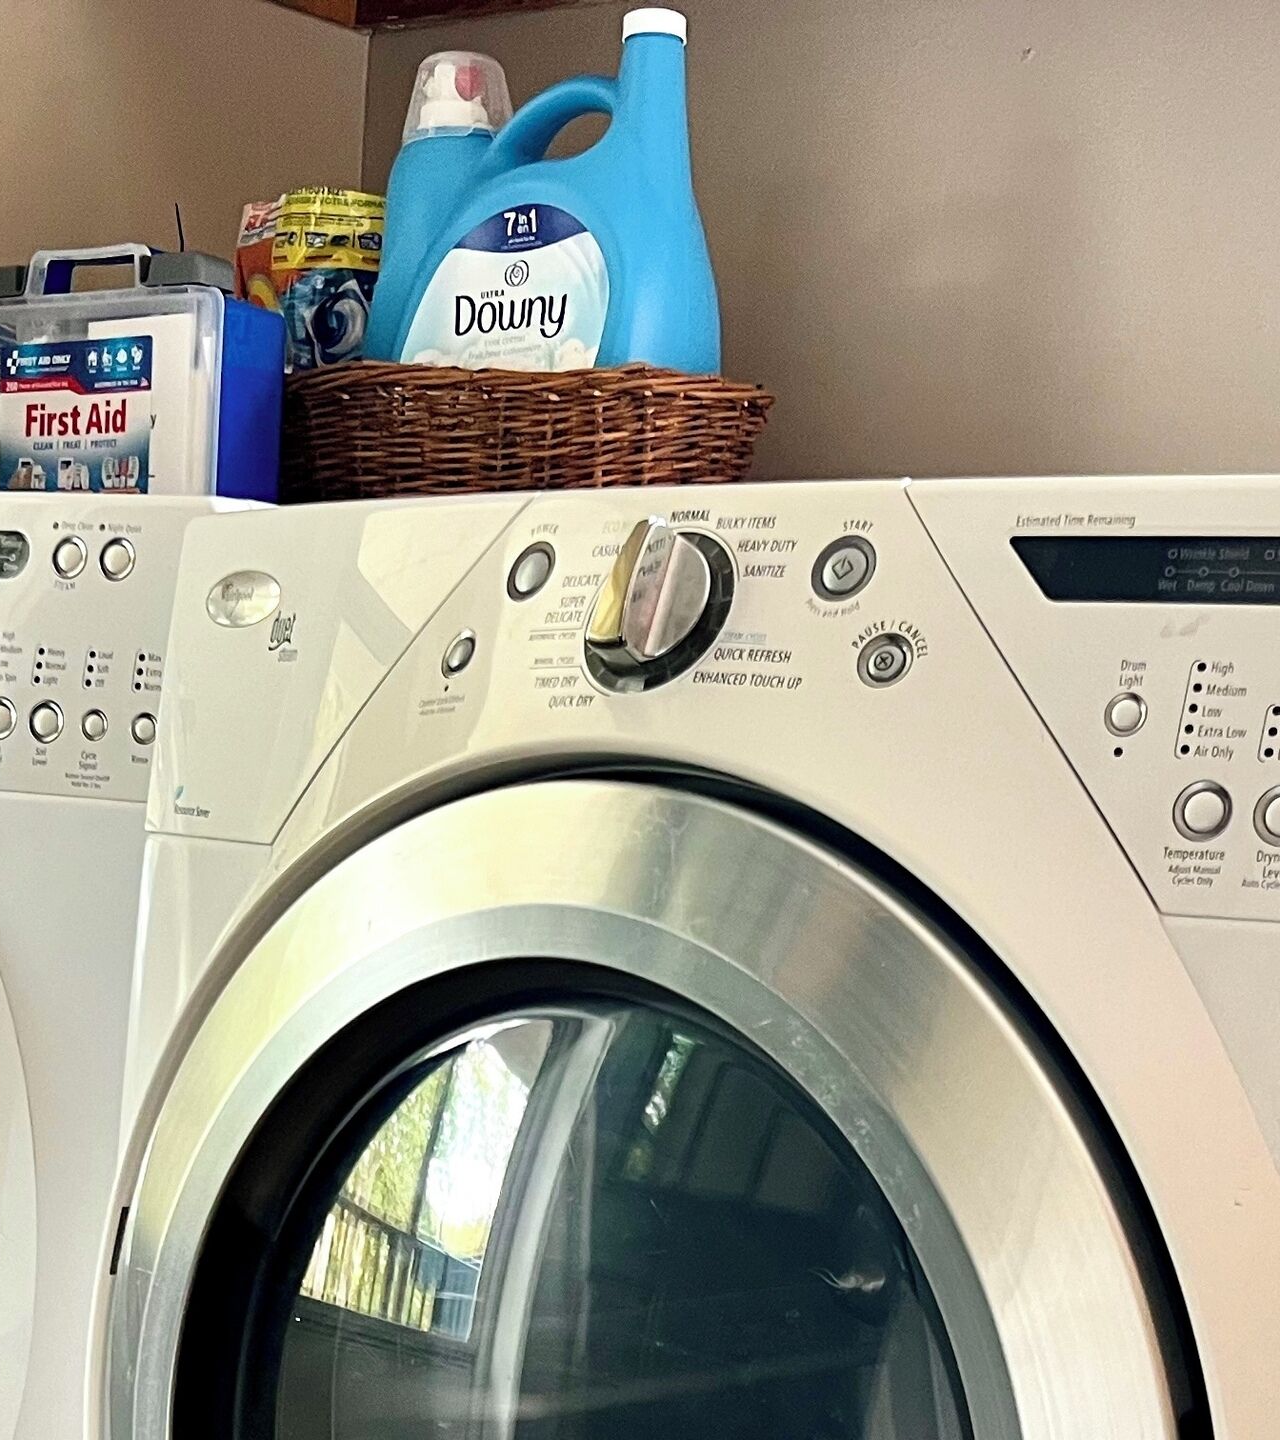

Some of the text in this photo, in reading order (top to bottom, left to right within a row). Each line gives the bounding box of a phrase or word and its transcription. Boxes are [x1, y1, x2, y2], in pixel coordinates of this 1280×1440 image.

[503, 208, 537, 236] 7 in 1
[480, 289, 505, 299] ULTRA
[455, 293, 568, 338] Downy
[38, 355, 51, 366] AID
[25, 403, 81, 438] First
[85, 398, 127, 435] Aid
[33, 439, 117, 451] CLEAN TREAT PROTECT
[670, 509, 711, 522] NORMAL
[1016, 514, 1136, 529] Estimated Time Remaining
[716, 517, 777, 529] BULKY ITEMS
[843, 520, 873, 533] START
[737, 540, 799, 552] HEAVY DUTY
[1179, 547, 1250, 561] Wrinkle Shield
[743, 565, 787, 578] SANITIZE
[562, 574, 602, 588] DELICATE
[1158, 580, 1178, 592] Wet
[1187, 579, 1216, 593] Damp
[1221, 579, 1274, 593] Cool Down
[560, 596, 586, 608] SUPER
[544, 611, 583, 624] DELICATE
[851, 620, 886, 649] PAUSE
[898, 620, 928, 659] CANCEL
[714, 648, 792, 663] QUICK REFRESH
[1121, 660, 1147, 671] Drum
[1211, 662, 1234, 678] High
[534, 676, 580, 689] TIMED DRY
[692, 671, 803, 691] ENHANCED TOUCH UP
[1119, 674, 1143, 689] Light
[1206, 684, 1247, 696] Medium
[548, 695, 595, 709] QUICK DRY
[1202, 705, 1223, 717] Low
[1197, 726, 1247, 738] Extra Low
[1193, 746, 1234, 761] Air Only
[1163, 846, 1226, 862] Temperature
[1168, 864, 1221, 876] Adjust Manual
[1172, 875, 1213, 888] Cycles Only
[1242, 878, 1259, 888] Auto
